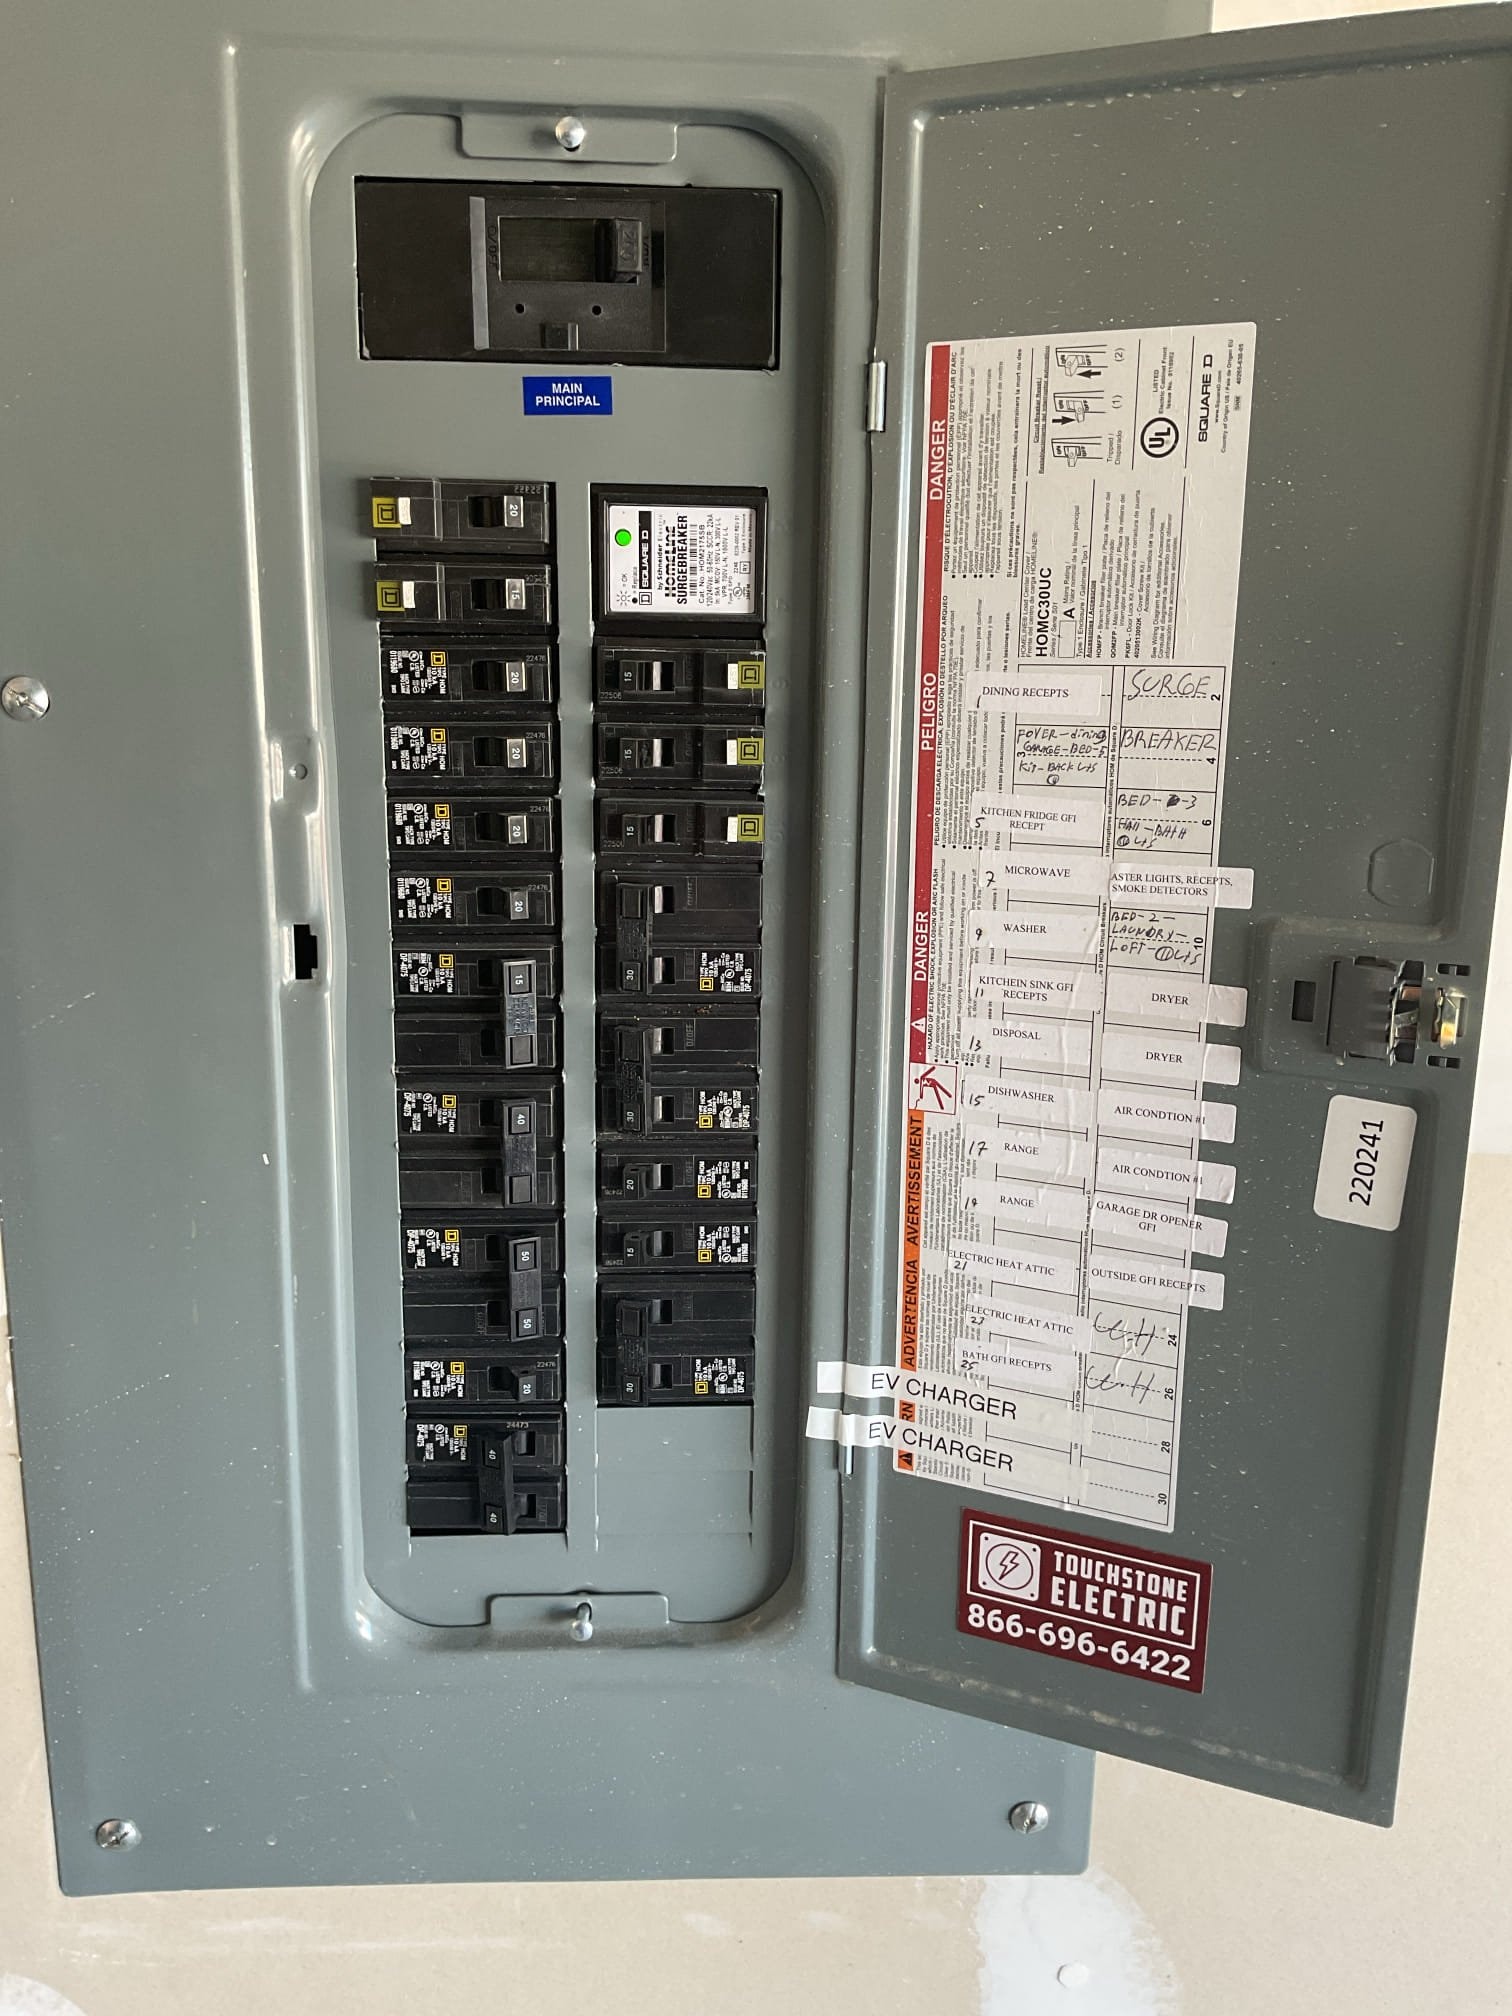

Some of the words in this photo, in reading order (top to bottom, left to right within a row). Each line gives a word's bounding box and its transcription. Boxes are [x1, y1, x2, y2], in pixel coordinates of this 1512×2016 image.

[1114, 348, 1124, 362] (2)
[1203, 354, 1212, 368] D
[552, 383, 582, 394] MAIN
[536, 395, 600, 406] PRINCIPAL
[1112, 395, 1123, 409] (1)
[1198, 373, 1211, 442] SQUARE
[949, 412, 955, 422] OU
[1149, 427, 1171, 448] UL
[1115, 430, 1123, 465] Disparado
[930, 419, 946, 500] DANGER
[510, 504, 518, 516] 20
[642, 530, 648, 539] D
[677, 516, 687, 604] SURGEBREAKER
[658, 582, 663, 590] by
[512, 590, 520, 600] 15
[1035, 568, 1051, 657] HOMC30UC
[1063, 607, 1074, 619] A
[511, 672, 519, 684] 20
[624, 672, 632, 681] 15
[1128, 669, 1210, 700] SURGE
[982, 687, 1020, 696] DINING
[1022, 688, 1069, 698] RECEPTS
[921, 673, 936, 750] PELIGRO
[1120, 729, 1216, 752] BREAKER
[513, 748, 520, 759] 20
[625, 749, 632, 759] 15
[935, 807, 940, 815] DE
[980, 807, 1022, 818] KITCHEN
[1024, 810, 1058, 821] FRIDGE
[1061, 814, 1076, 823] GFI
[975, 817, 985, 828] 5
[1010, 821, 1045, 831] RECEPT
[513, 826, 521, 837] 20
[627, 826, 634, 836] 15
[1004, 865, 1071, 878] MICROWAVE
[986, 871, 996, 887] 7
[1145, 874, 1183, 884] LIGHTS,
[1186, 876, 1233, 887] RECEPTS,
[1112, 885, 1146, 894] SMOKE
[1150, 886, 1208, 896] DETECTORS
[515, 901, 523, 913] 20
[976, 928, 982, 940] 9
[1003, 924, 1047, 933] WASHER
[914, 912, 929, 981] DANGER
[1194, 937, 1204, 950] 10
[928, 1014, 933, 1022] OF
[931, 907, 937, 916] OR
[515, 974, 523, 985] 15
[626, 970, 634, 980] 30
[979, 976, 1026, 988] KITCHEIN
[1030, 981, 1054, 990] SINK
[1056, 982, 1074, 992] GFI
[1003, 990, 1048, 1001] RECEPTS
[1152, 993, 1188, 1005] DRYER
[992, 1028, 1041, 1040] DISPOSAL
[969, 1035, 982, 1052] 13
[1146, 1051, 1183, 1063] DRYER
[970, 1094, 985, 1106] 15
[988, 1086, 1055, 1103] DISHWASHER
[517, 1113, 525, 1125] 40
[626, 1111, 634, 1123] 30
[1114, 1106, 1133, 1115] AIR
[1136, 1108, 1192, 1122] CONDTION
[1196, 1115, 1206, 1124] #1
[969, 1141, 988, 1156] 17
[1004, 1143, 1039, 1155] RANGE
[1350, 1120, 1384, 1206] 220241
[1113, 1164, 1130, 1174] AIR
[1133, 1167, 1190, 1182] CONDTION
[1193, 1176, 1203, 1184] #1
[626, 1179, 634, 1190] 20
[906, 1116, 922, 1246] AVERTISSEMENT
[1000, 1196, 1034, 1207] RANGE
[1096, 1201, 1141, 1216] GARAGE
[1143, 1210, 1158, 1220] DR
[1160, 1215, 1203, 1230] OPENER
[1139, 1222, 1156, 1232] GFI
[522, 1251, 529, 1262] 50
[627, 1248, 634, 1258] 15
[948, 1250, 994, 1265] ELECTRIC
[996, 1258, 1023, 1268] HEAT
[1025, 1265, 1055, 1275] ATTIC
[954, 1261, 967, 1271] 21
[1092, 1268, 1137, 1282] OUTSIDE
[1139, 1276, 1156, 1285] GFI
[1160, 1279, 1206, 1293] RECEPTS
[904, 1260, 917, 1367] ADVERTENCIA
[966, 1304, 1013, 1321] ELECTRIC
[1014, 1316, 1041, 1328] HEAT
[1043, 1322, 1073, 1334] ATTIC
[523, 1319, 531, 1329] 50
[1168, 1334, 1177, 1346] 24
[960, 1360, 979, 1370] 25
[962, 1350, 988, 1361] BATH
[991, 1355, 1006, 1364] GFI
[1009, 1358, 1052, 1372] RECEPTS
[523, 1384, 531, 1395] 20
[626, 1383, 634, 1393] 30
[1164, 1388, 1174, 1400] 26
[872, 1373, 900, 1390] EV
[906, 1379, 1016, 1420] CHARGER
[869, 1422, 896, 1439] EV
[902, 1429, 1013, 1472] CHARGER
[1161, 1440, 1171, 1453] 28
[489, 1449, 496, 1460] 40
[1158, 1493, 1167, 1505] 30
[490, 1512, 497, 1523] 40
[1054, 1551, 1187, 1602] TOUCHSTONE
[1052, 1576, 1186, 1636] ELECTRIC
[968, 1604, 1191, 1681] 866-696-6422
